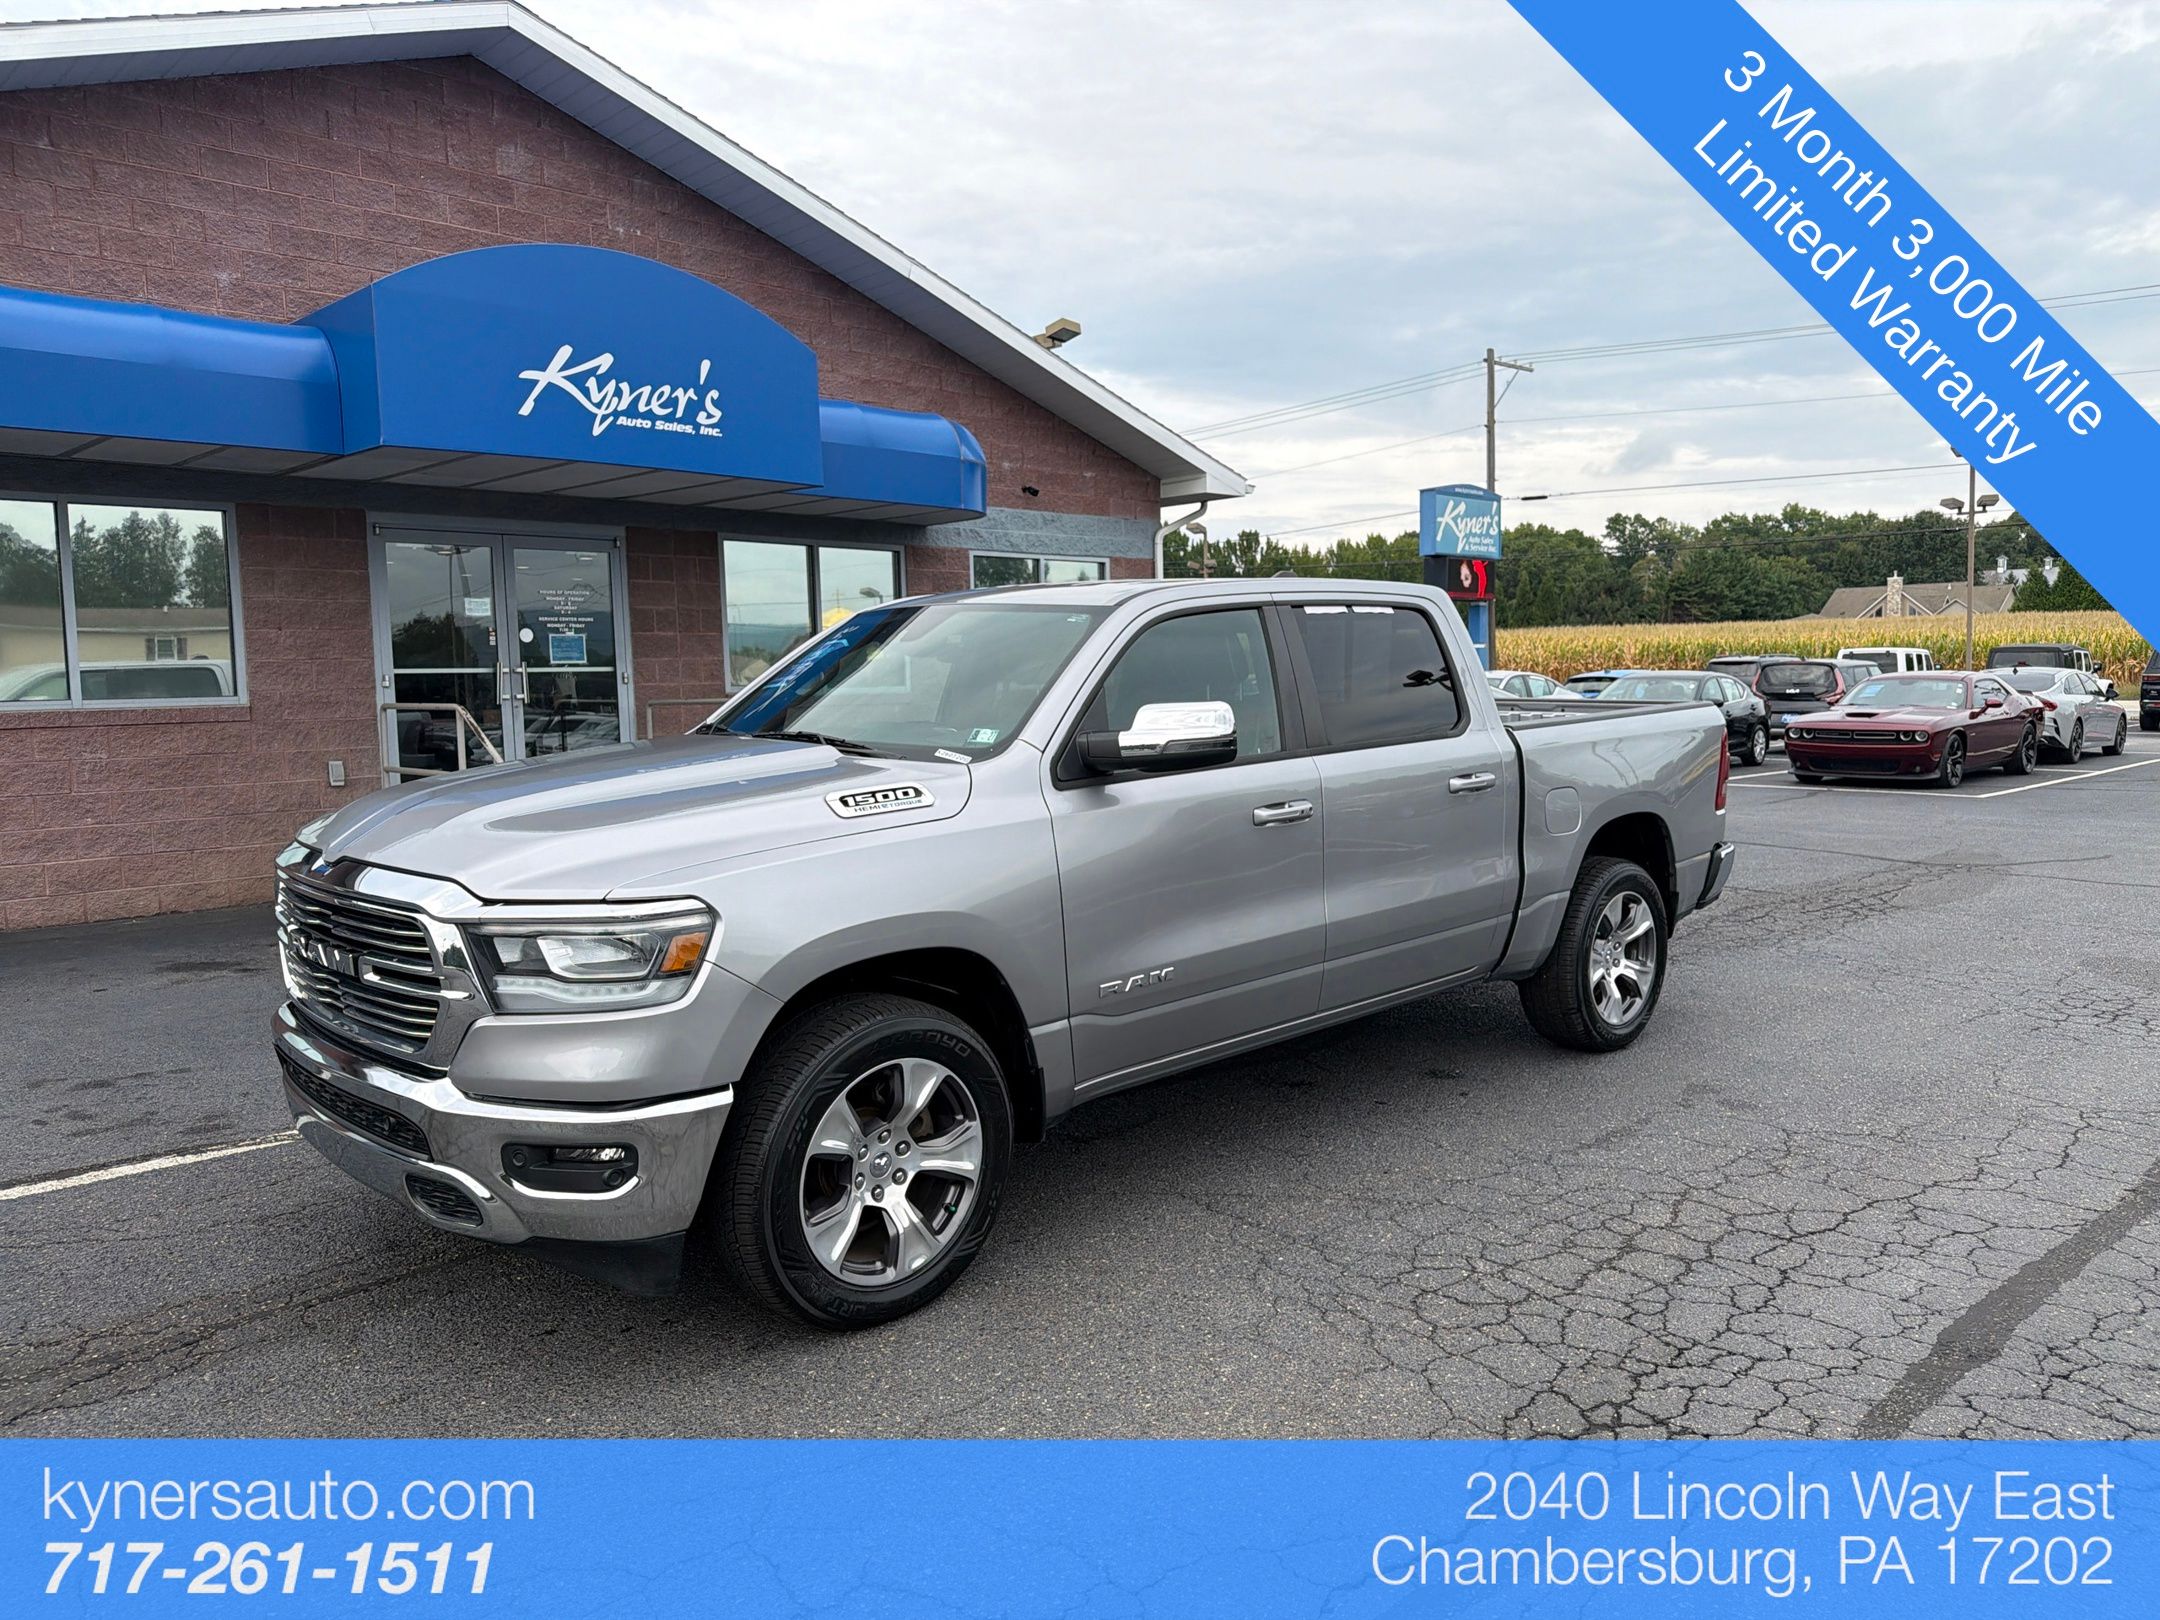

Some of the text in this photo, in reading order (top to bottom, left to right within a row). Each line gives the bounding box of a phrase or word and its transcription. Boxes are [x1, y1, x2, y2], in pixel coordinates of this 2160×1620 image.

[518, 344, 723, 437] Kyner's
[616, 416, 723, 437] Auto Sales, Inc.
[1436, 500, 1499, 554] Kyner's
[842, 788, 916, 807] 1500
[854, 803, 881, 813] HEMI
[1099, 966, 1175, 999] RAM
